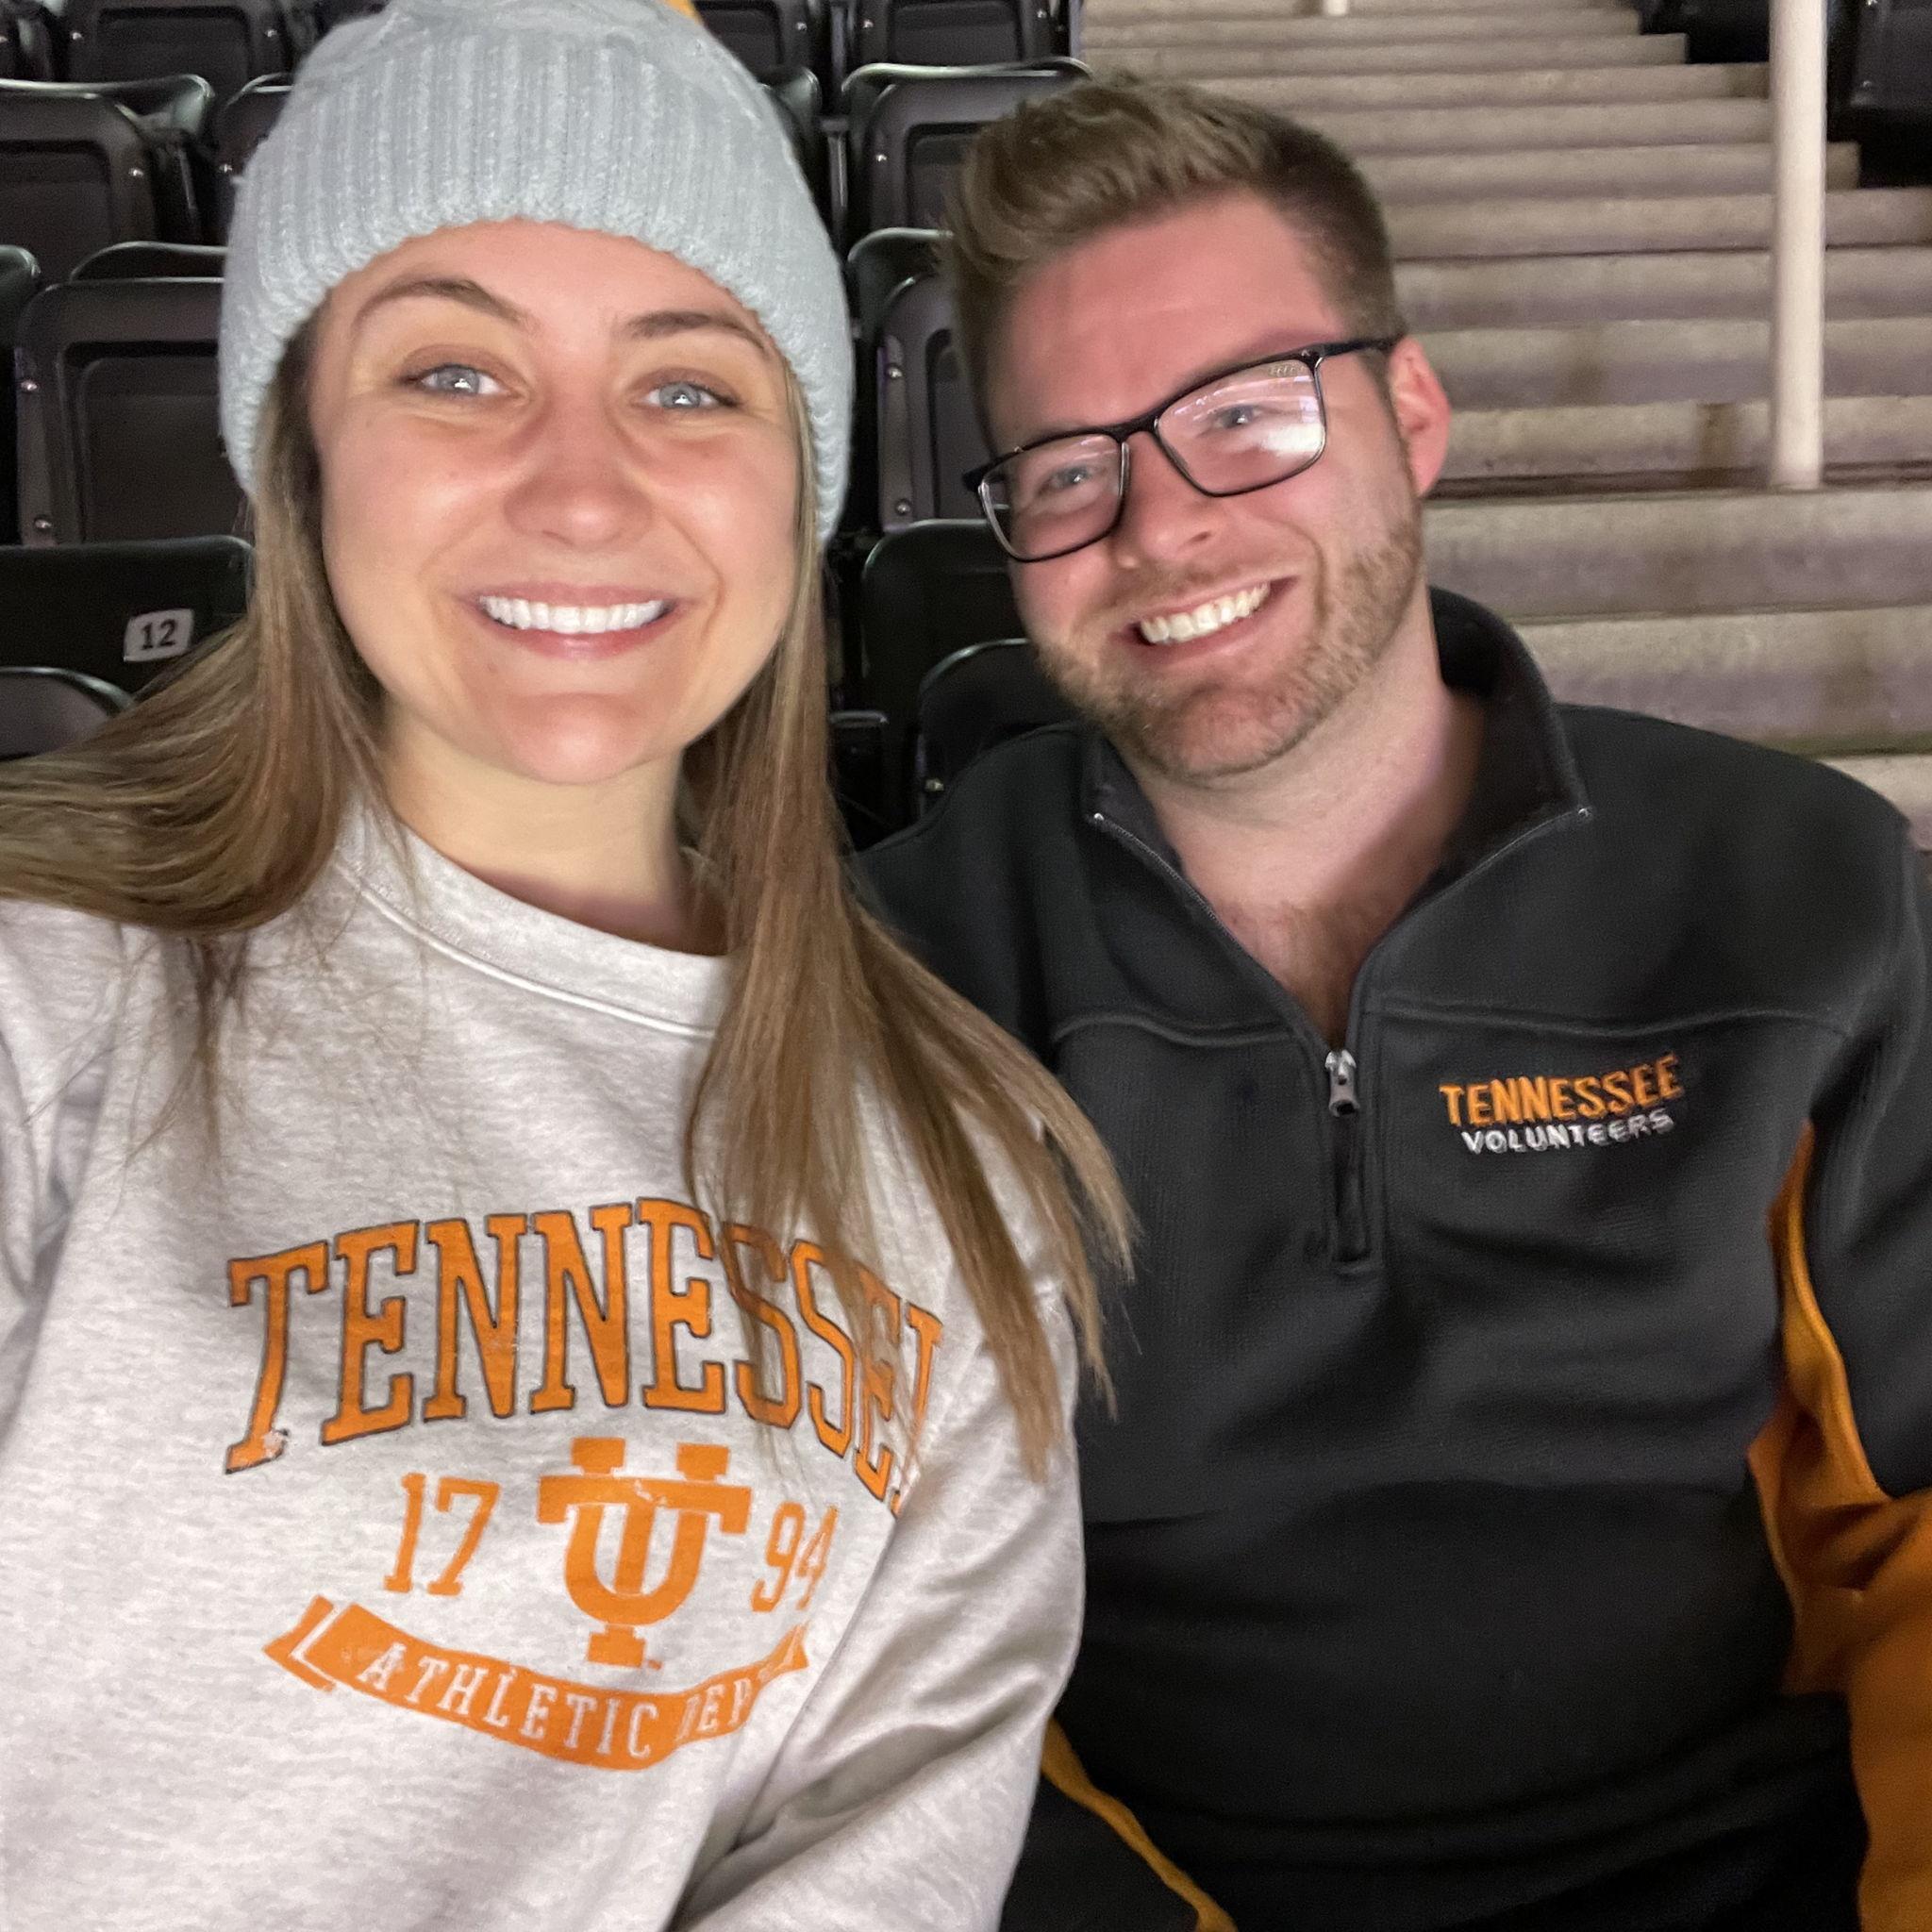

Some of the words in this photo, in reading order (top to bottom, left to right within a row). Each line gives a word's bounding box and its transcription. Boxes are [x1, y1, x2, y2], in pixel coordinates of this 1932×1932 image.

[141, 618, 176, 650] 12
[1439, 1050, 1686, 1127] TENNESSEE
[1461, 1108, 1675, 1155] VOLUNTEERS
[383, 1472, 503, 1596] 17
[750, 1499, 839, 1613] 94
[357, 1641, 658, 1759] ATHLETIC
